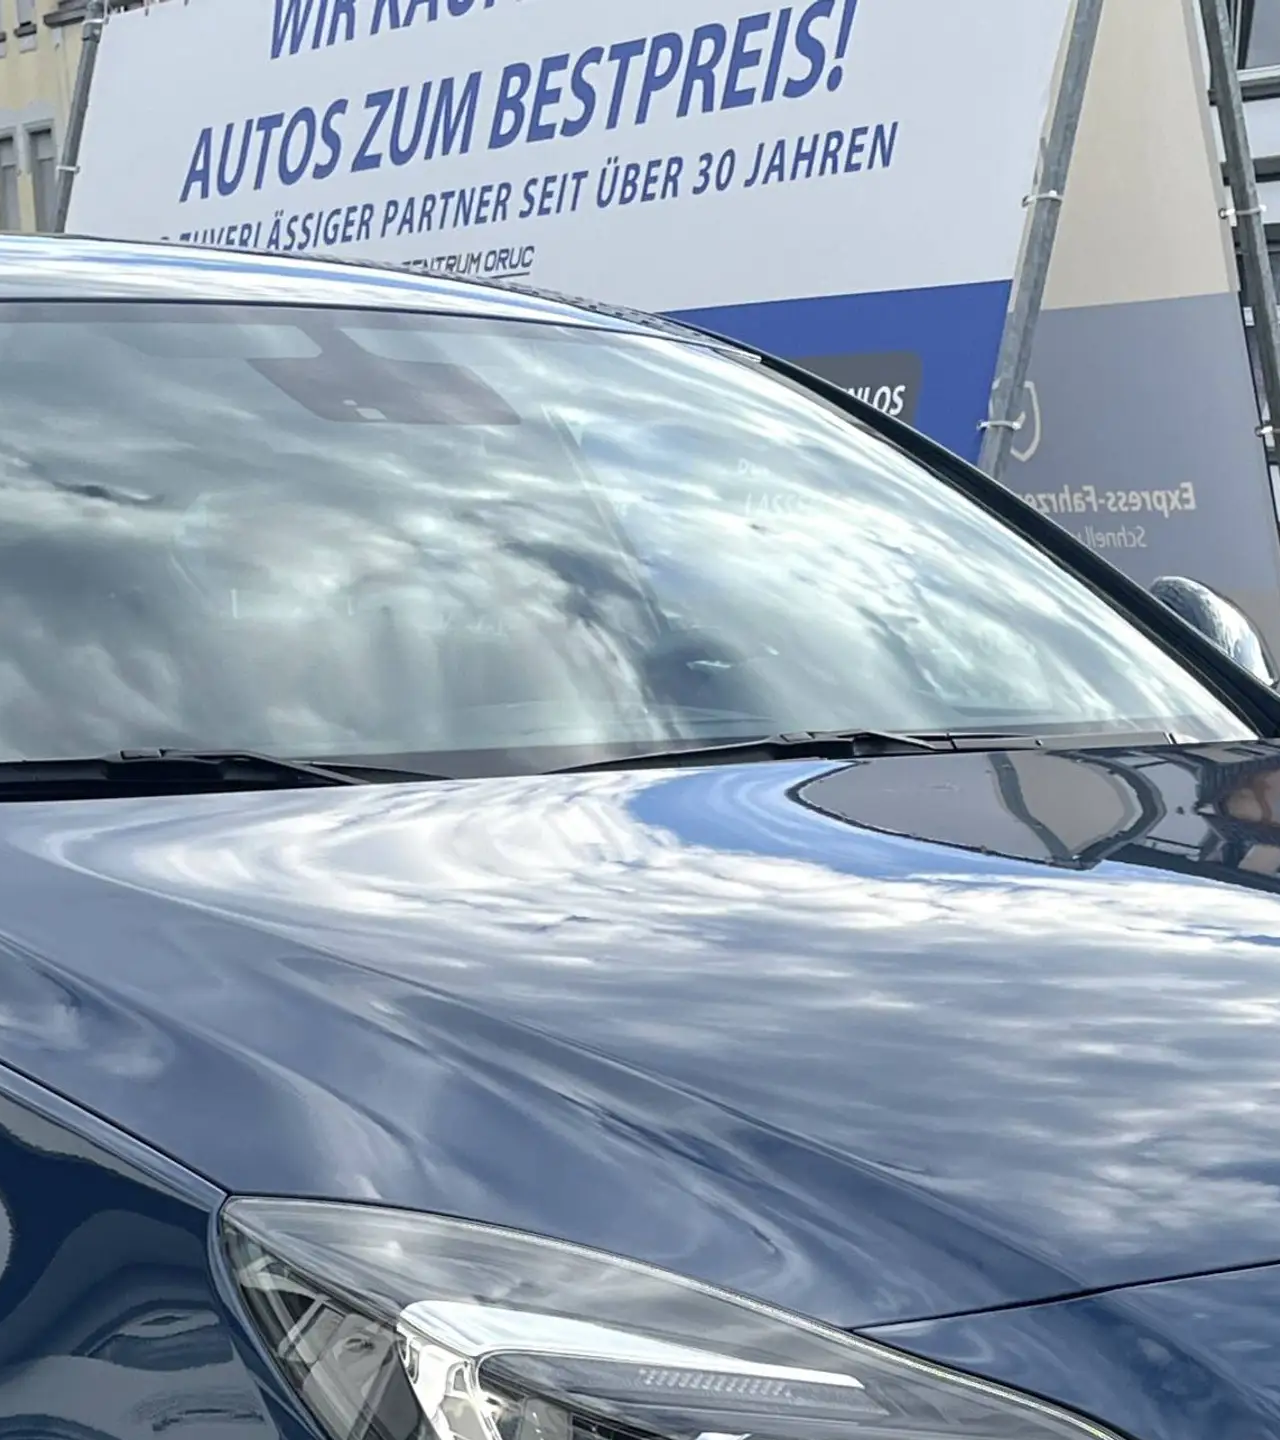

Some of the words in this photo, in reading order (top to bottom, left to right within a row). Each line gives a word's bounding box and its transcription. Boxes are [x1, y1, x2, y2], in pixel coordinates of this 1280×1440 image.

[182, 98, 348, 202] AUTOS
[352, 71, 482, 172] ZUM
[488, 0, 857, 150] BESTPREIS!
[380, 182, 512, 238] PARTNER
[519, 170, 588, 219] SEIT
[595, 156, 684, 209] ÜBER
[692, 148, 736, 195] 30
[743, 121, 899, 189] JAHREN
[484, 246, 536, 273] ORUC
